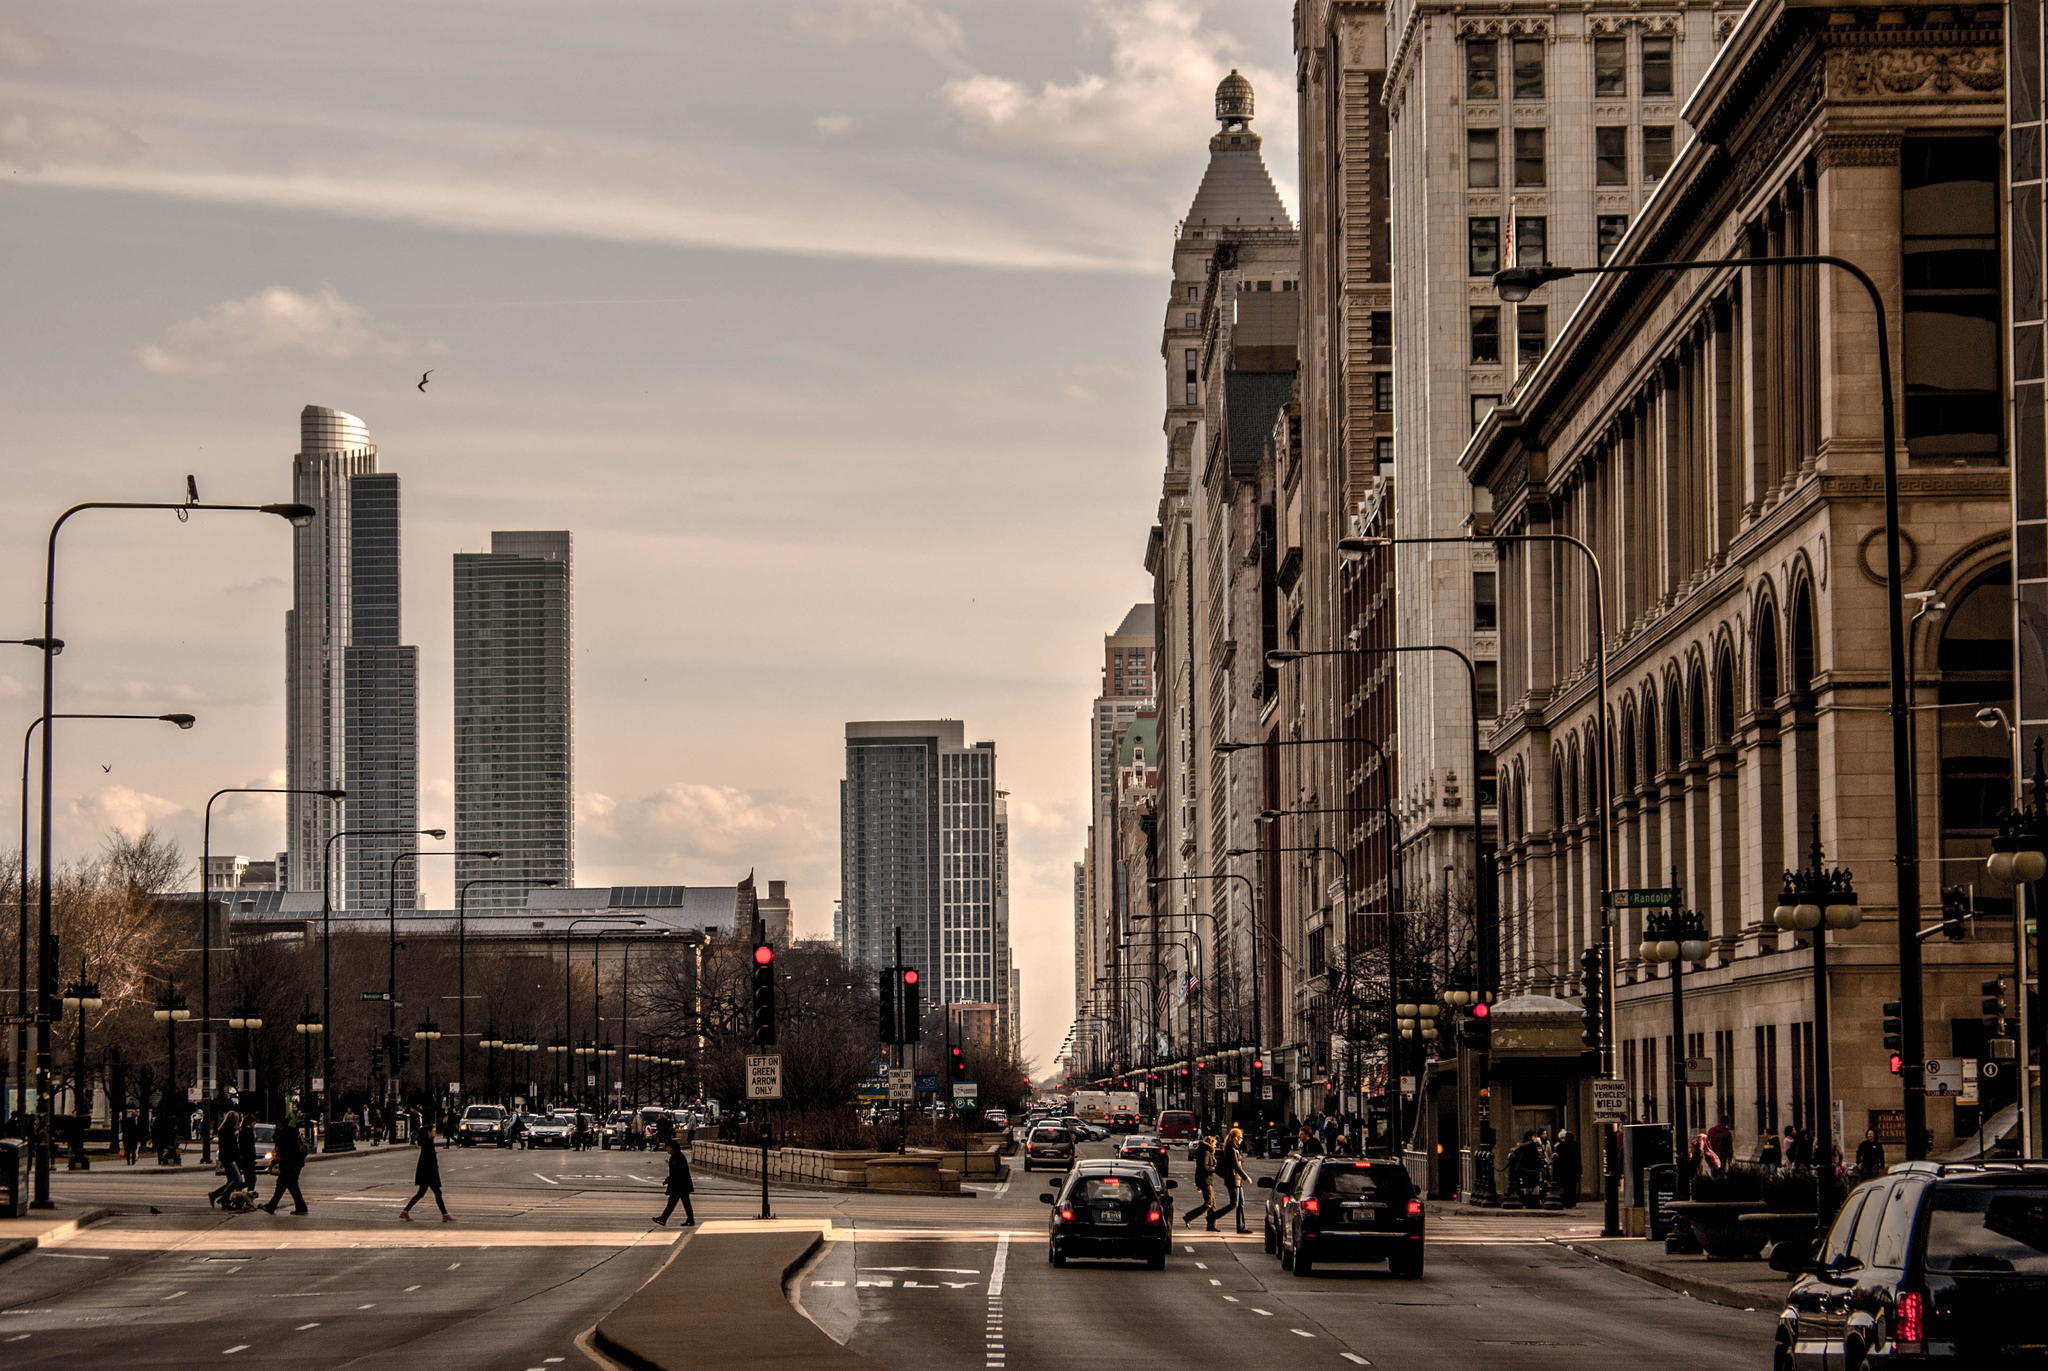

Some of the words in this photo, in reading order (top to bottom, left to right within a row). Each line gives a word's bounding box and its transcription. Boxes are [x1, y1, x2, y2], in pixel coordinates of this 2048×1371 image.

[748, 1058, 766, 1066] LEFT
[768, 1058, 778, 1066] ON
[752, 1068, 775, 1076] GREEN
[752, 1076, 776, 1085] ARROW
[755, 1086, 773, 1094] ONLY
[1597, 1099, 1622, 1108] YIELD
[811, 1280, 980, 1289] ONLY
